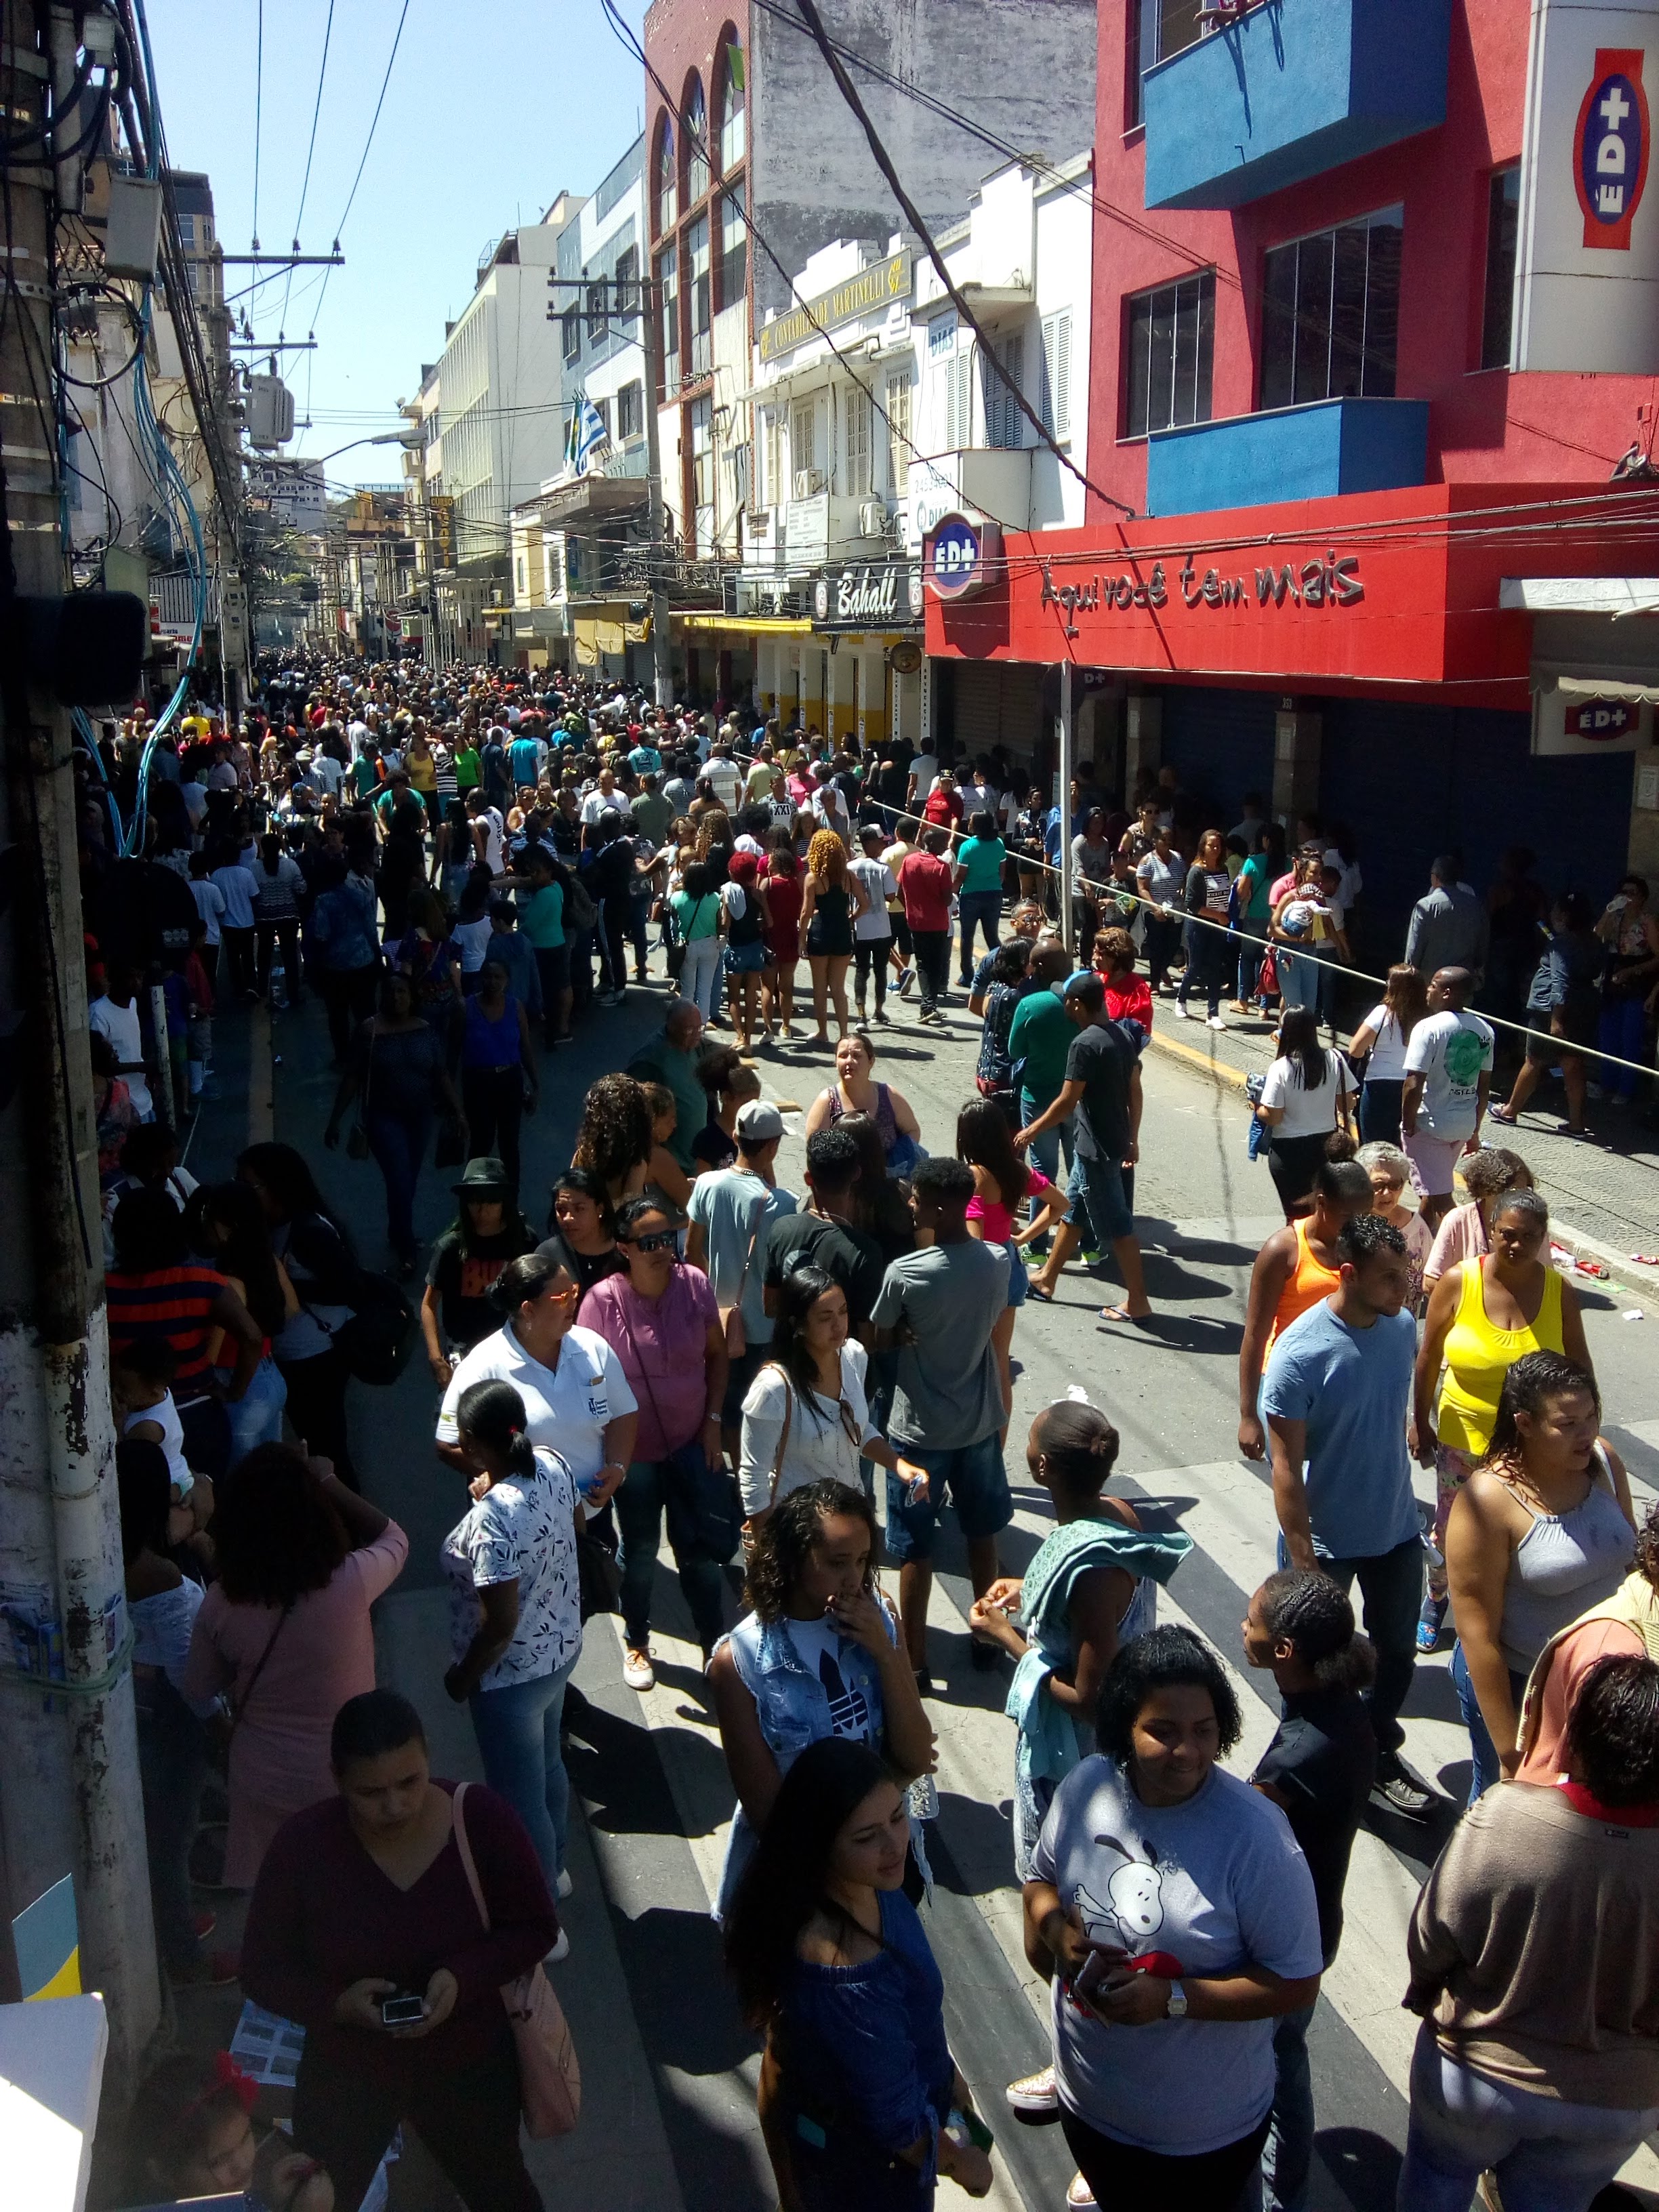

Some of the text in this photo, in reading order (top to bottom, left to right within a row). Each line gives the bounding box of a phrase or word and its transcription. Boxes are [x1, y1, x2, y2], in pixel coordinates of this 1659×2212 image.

[775, 270, 884, 349] CONTABILIDADE MARTINELLI
[931, 326, 954, 358] DIAS
[929, 506, 948, 527] DIA
[1041, 548, 1365, 633] Aqui você tem mais
[774, 804, 790, 816] XXI
